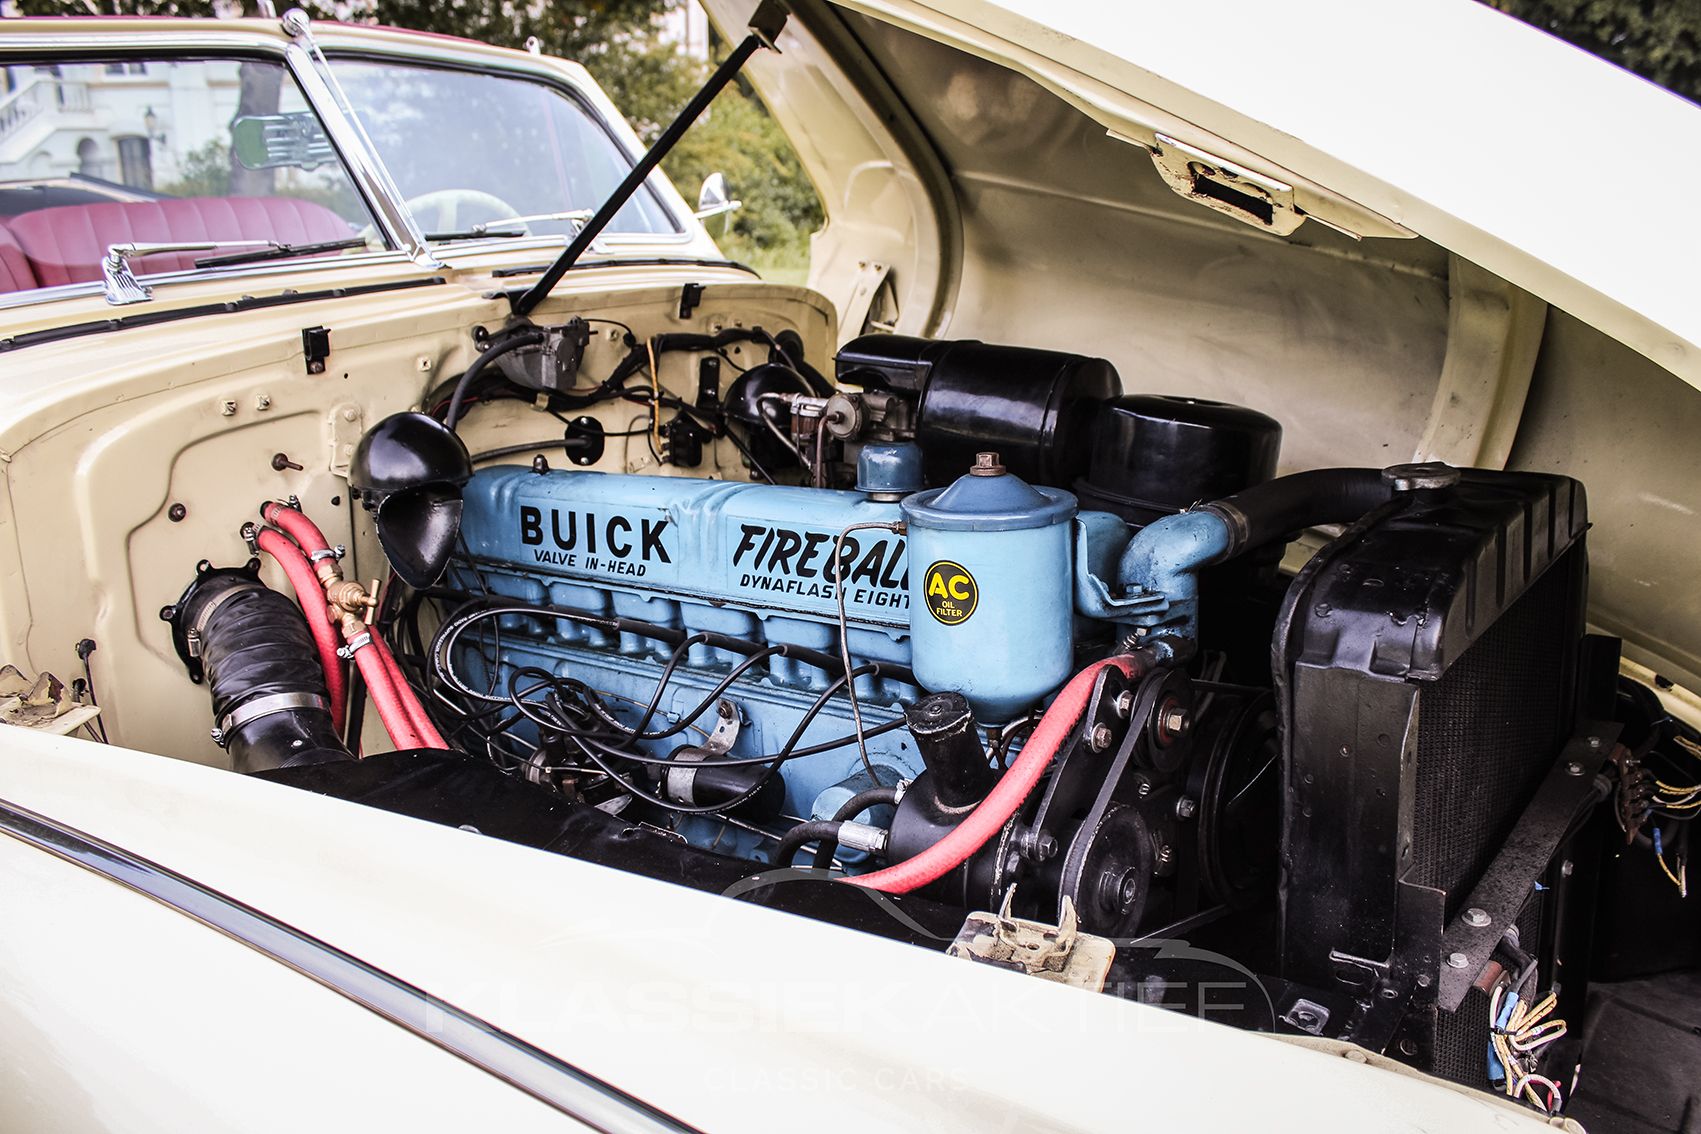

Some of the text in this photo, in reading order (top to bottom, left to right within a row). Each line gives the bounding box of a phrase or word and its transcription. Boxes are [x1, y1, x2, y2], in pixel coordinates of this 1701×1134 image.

[520, 505, 672, 564] BUICK
[534, 548, 647, 577] VALVE IN-HEAD
[732, 523, 909, 591] FIREBAL
[928, 572, 970, 601] AC
[936, 607, 963, 617] FILTER
[941, 600, 956, 609] OIL
